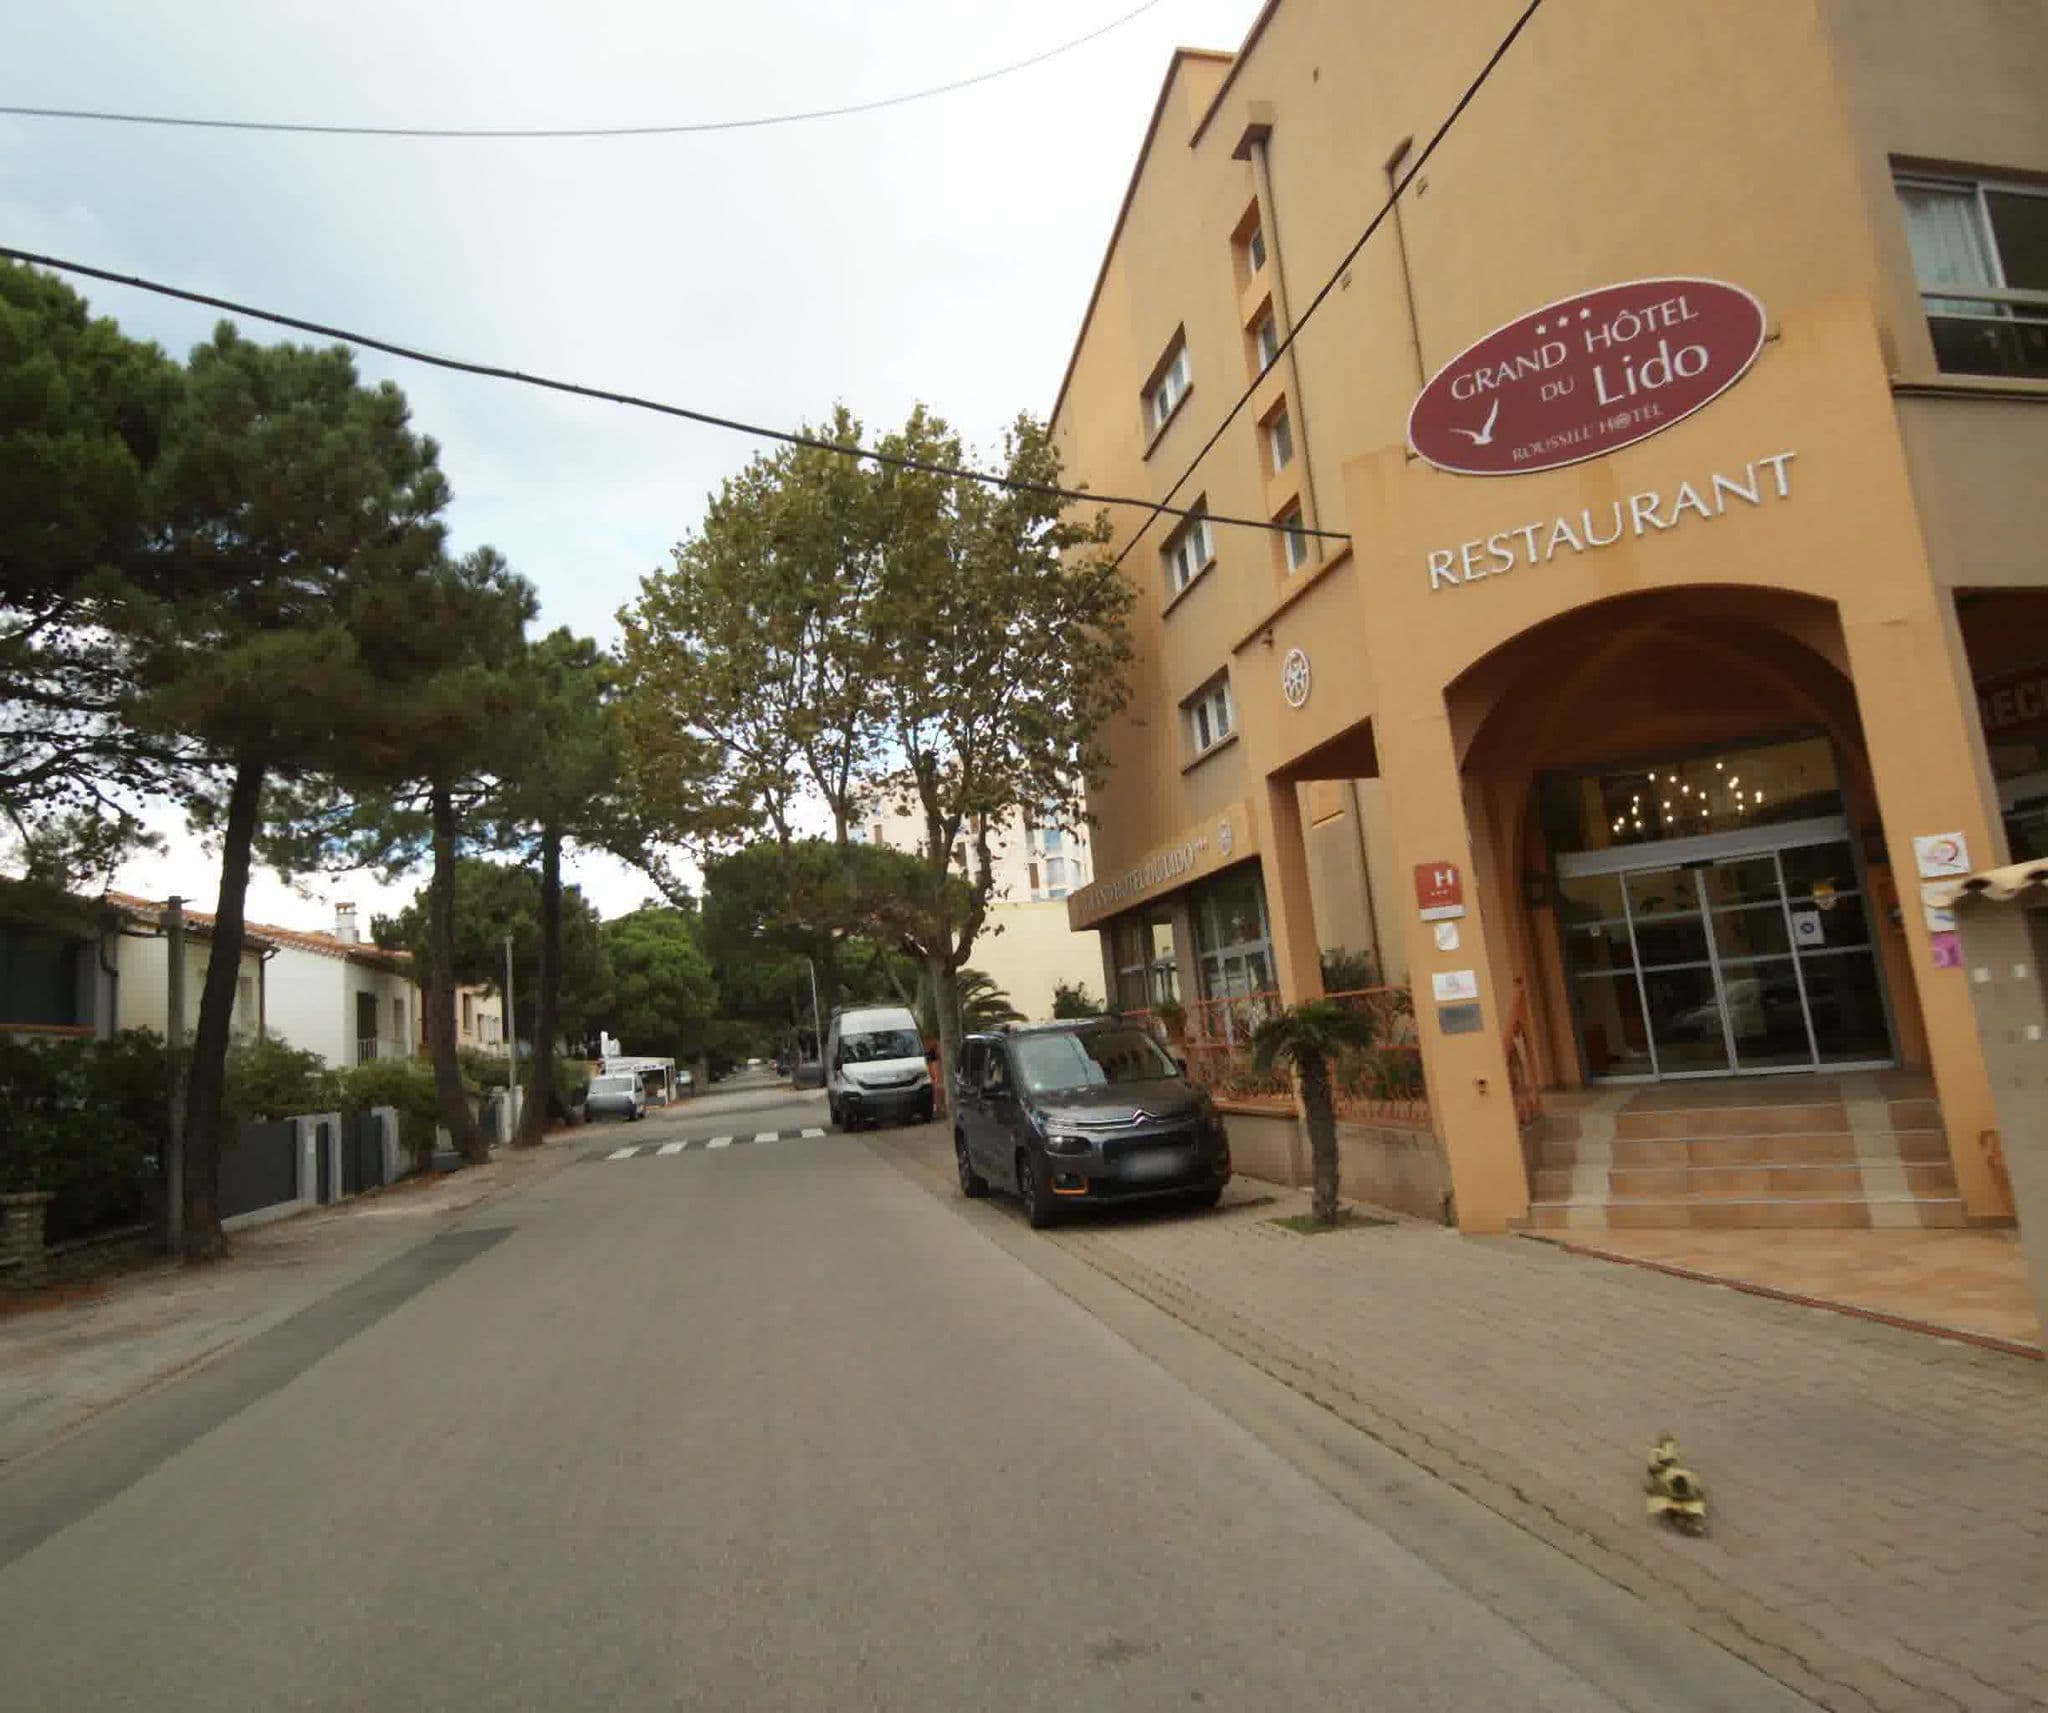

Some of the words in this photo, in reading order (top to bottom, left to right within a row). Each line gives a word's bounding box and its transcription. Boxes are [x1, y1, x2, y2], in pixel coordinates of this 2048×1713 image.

[1450, 341, 1567, 400] GRAND
[1584, 295, 1699, 353] HÔTEL
[1540, 376, 1575, 402] DU
[1592, 338, 1709, 406] Lido
[1426, 449, 1799, 591] RESTAURANT
